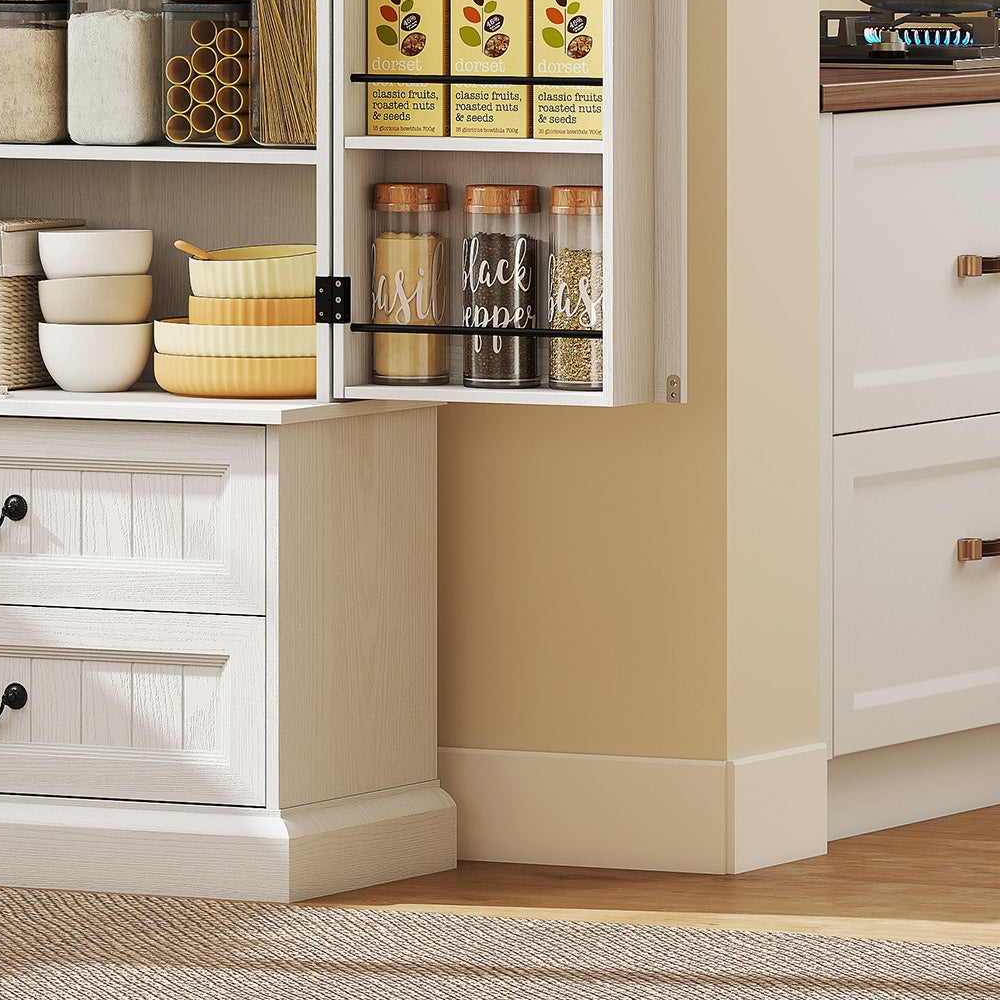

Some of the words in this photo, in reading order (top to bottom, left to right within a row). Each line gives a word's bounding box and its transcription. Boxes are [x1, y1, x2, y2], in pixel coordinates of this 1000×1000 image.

[372, 57, 422, 71] dorset
[455, 58, 506, 72] dorset
[538, 59, 588, 74] dorset
[372, 89, 406, 98] classic
[408, 90, 438, 100] fruits,
[455, 91, 489, 99] classic
[492, 91, 522, 102] fruits,
[538, 92, 572, 101] classic
[372, 101, 409, 109] roasted
[412, 102, 435, 110] nuts
[455, 102, 493, 111] roasted
[538, 104, 575, 112] roasted
[578, 104, 602, 113] nuts
[372, 111, 381, 120] &
[383, 112, 410, 120] seeds
[456, 113, 464, 122] &
[466, 114, 494, 122] seeds
[538, 114, 547, 123] &
[549, 115, 577, 124] seeds
[547, 253, 603, 327] bas
[462, 304, 536, 353] epper
